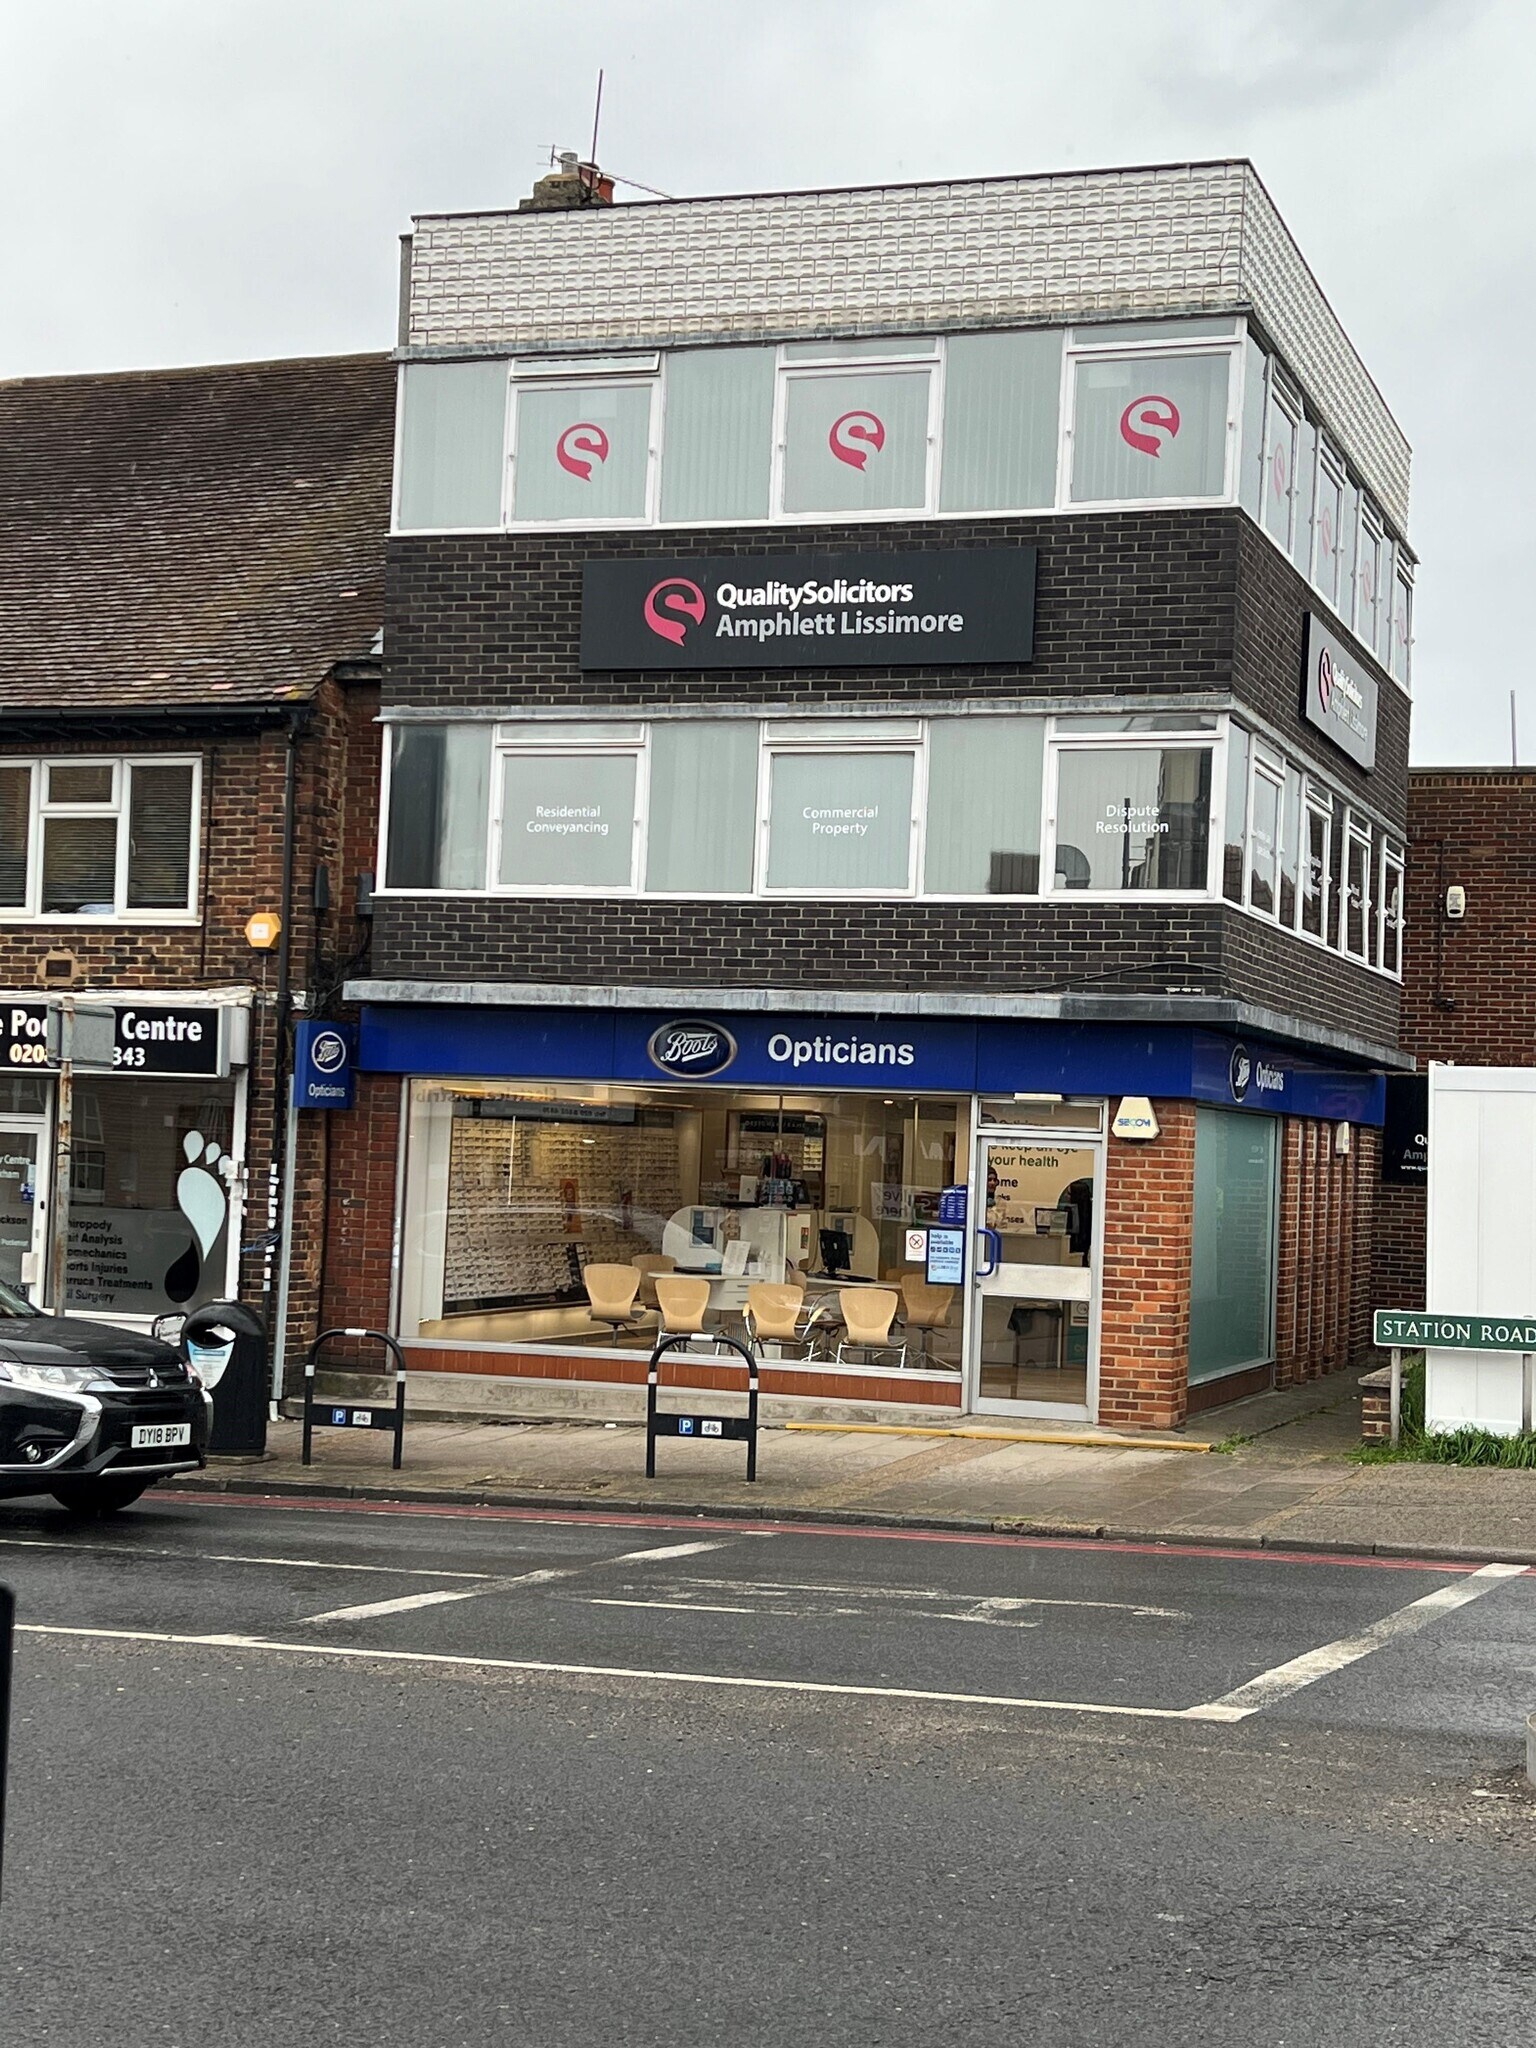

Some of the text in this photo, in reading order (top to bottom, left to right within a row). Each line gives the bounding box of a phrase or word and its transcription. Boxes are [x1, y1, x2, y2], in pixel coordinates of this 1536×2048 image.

[715, 580, 913, 611] QualitySolicitors
[715, 609, 964, 643] Amphlett Lissimore
[536, 805, 601, 818] Residential
[803, 806, 879, 819] Commercial
[1106, 804, 1160, 819] Dispute
[526, 821, 609, 835] Conveyancing
[812, 822, 868, 837] Property
[1095, 821, 1169, 833] Resolution
[121, 1012, 203, 1041] Centre
[660, 1031, 914, 1067] Boots Opticians
[308, 1083, 346, 1099] Opticians
[4, 1154, 31, 1165] Centre
[988, 1155, 1059, 1168] your health
[67, 1220, 112, 1232] hiropody
[81, 1233, 123, 1246] Analysis
[67, 1248, 127, 1259] omechanics
[66, 1262, 128, 1275] orts Injuries
[66, 1276, 153, 1290] rruca Treatments
[75, 1289, 115, 1303] Surgery
[1383, 1320, 1536, 1343] STATION ROAD
[682, 1420, 691, 1432] P
[138, 1426, 185, 1444] DY18 BPV
